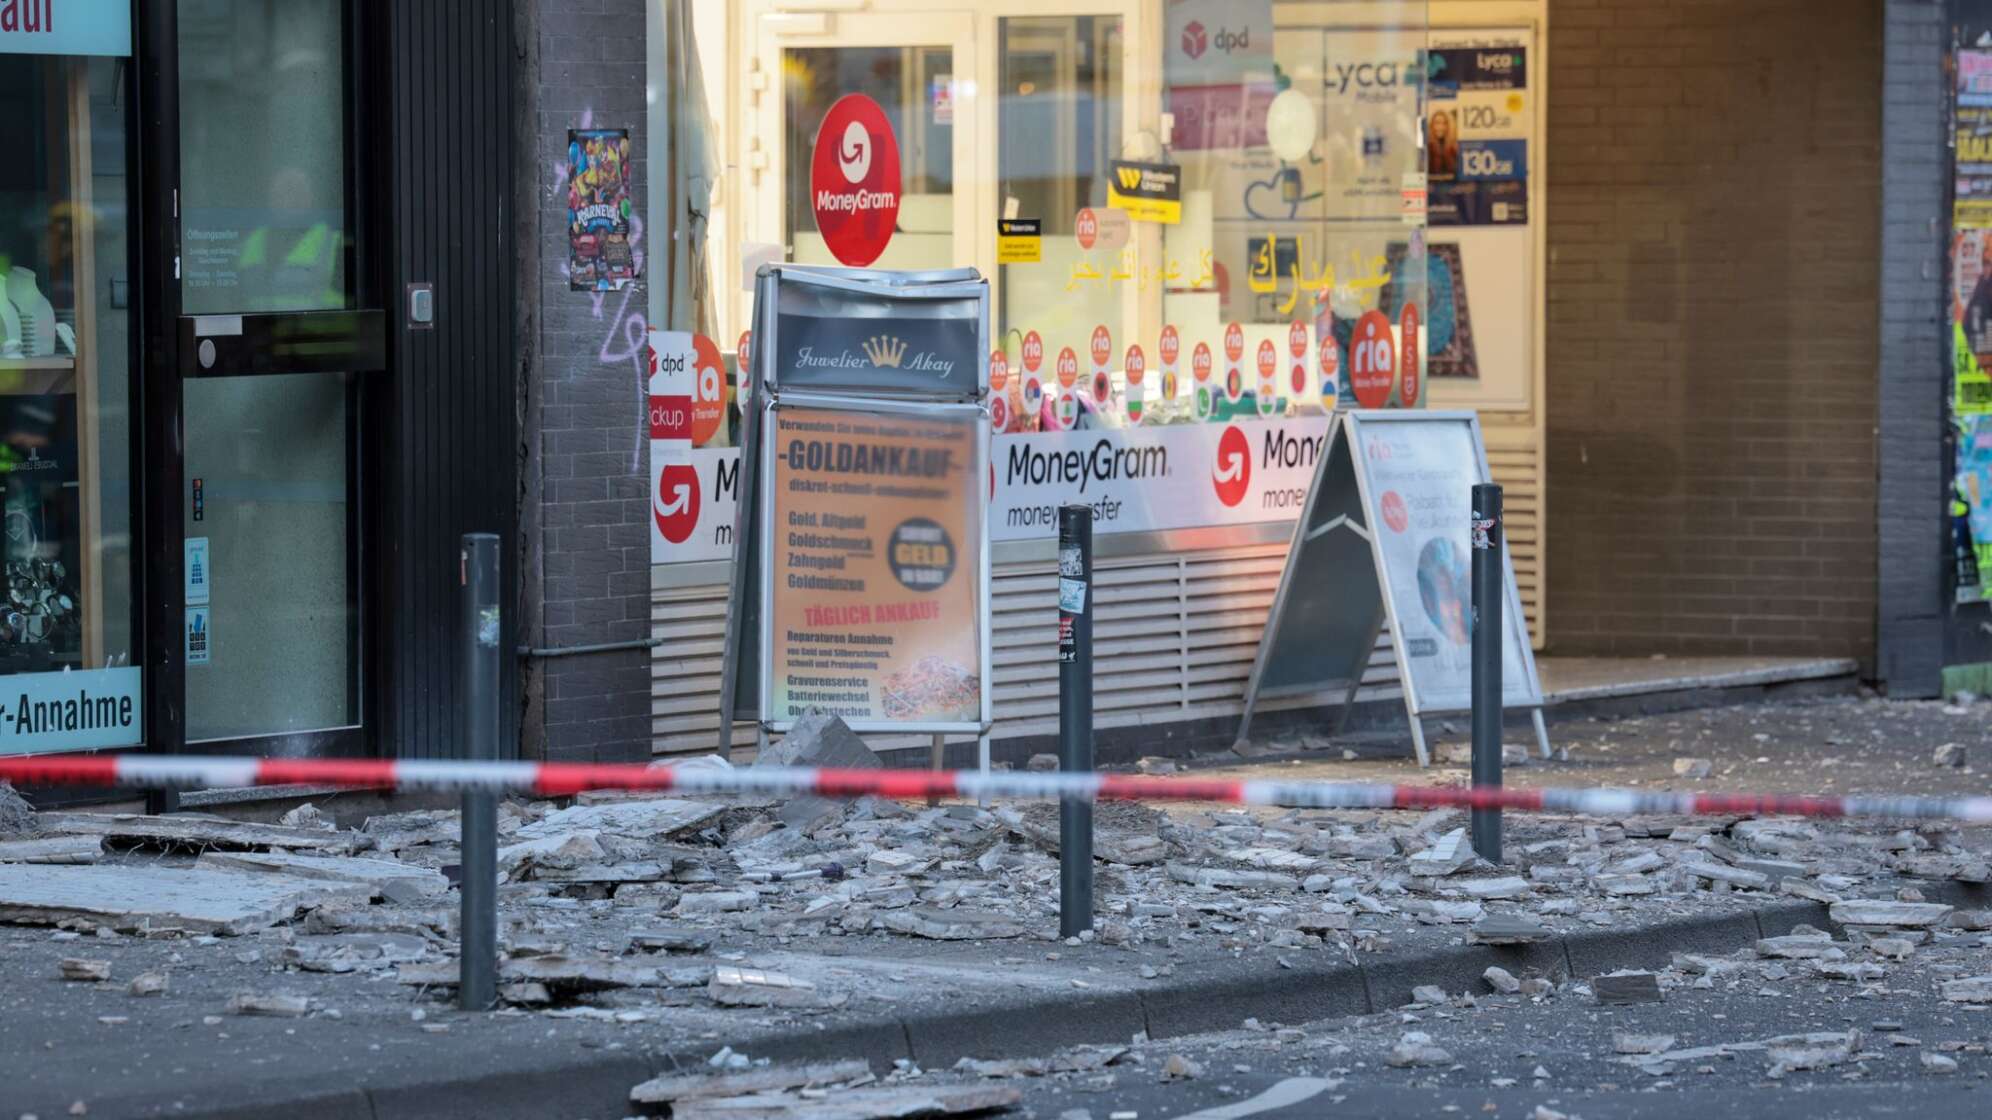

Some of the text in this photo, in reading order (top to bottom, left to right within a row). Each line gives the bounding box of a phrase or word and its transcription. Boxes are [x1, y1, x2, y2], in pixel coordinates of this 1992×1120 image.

[1214, 25, 1249, 54] dpd
[1323, 56, 1398, 94] Lyca
[817, 188, 895, 216] MoneyGram
[1024, 335, 1040, 357] ria
[1093, 329, 1109, 351] ria
[1162, 329, 1177, 351] ria
[1226, 326, 1241, 347] ria
[1291, 325, 1306, 345] ria
[1195, 347, 1210, 368] ria
[1259, 343, 1274, 364] ria
[1322, 340, 1337, 361] ria
[1355, 322, 1391, 373] ria
[662, 353, 684, 376] dpd
[796, 347, 954, 378] Juwelier Akay
[991, 353, 1006, 376] ria
[1060, 351, 1075, 373] ria
[1128, 350, 1143, 370] ria
[1007, 439, 1167, 493] MoneyGram
[1263, 486, 1306, 509] mone
[1007, 504, 1059, 530] money
[804, 601, 940, 627] TÄGLICH ANKAUF
[787, 630, 893, 645] Reparaturen Annahme
[787, 690, 869, 702] Batteriewechsel
